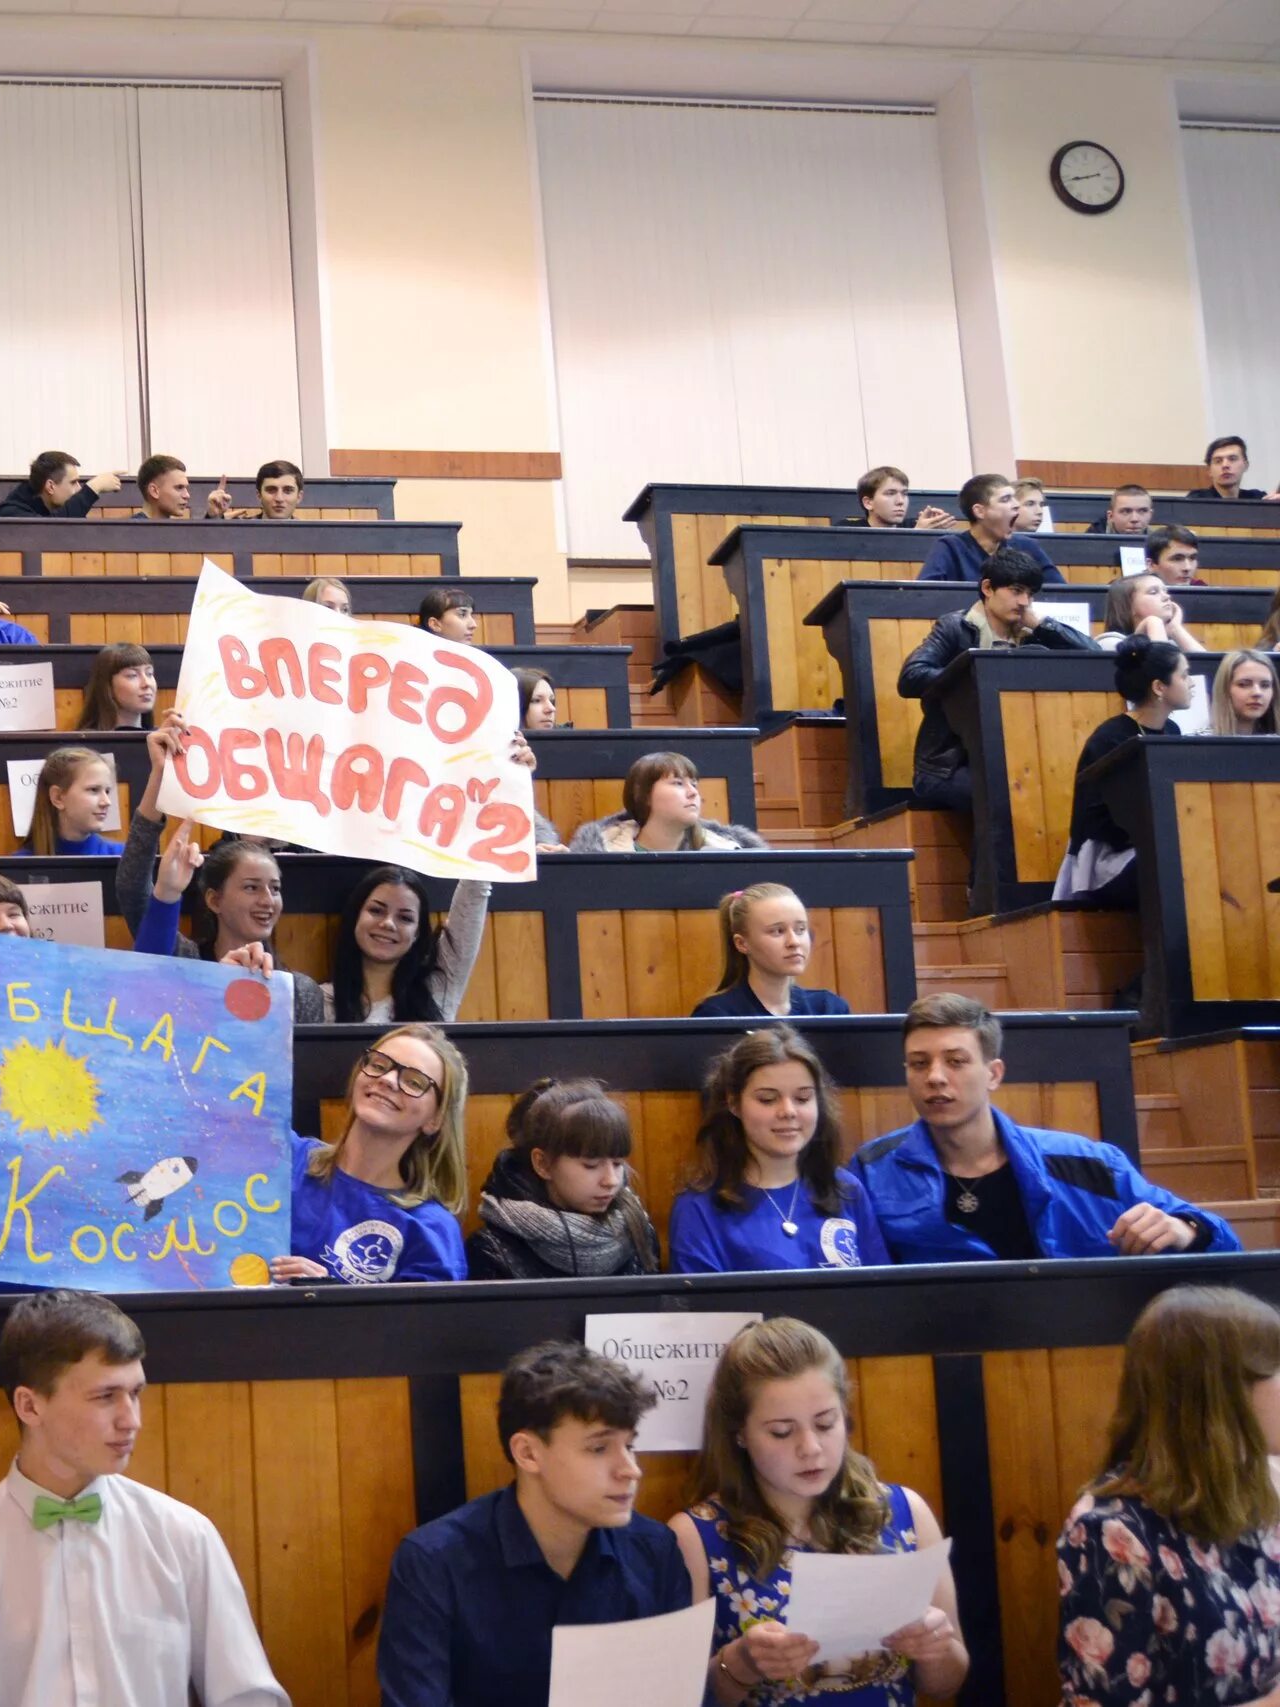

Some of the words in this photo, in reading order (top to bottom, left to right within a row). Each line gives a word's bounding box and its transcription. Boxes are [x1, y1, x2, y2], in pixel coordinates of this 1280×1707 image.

[172, 725, 466, 847] ОБЩАГА
[29, 902, 89, 915] ежитие
[602, 1337, 727, 1361] Общежити
[653, 1379, 689, 1400] №2
